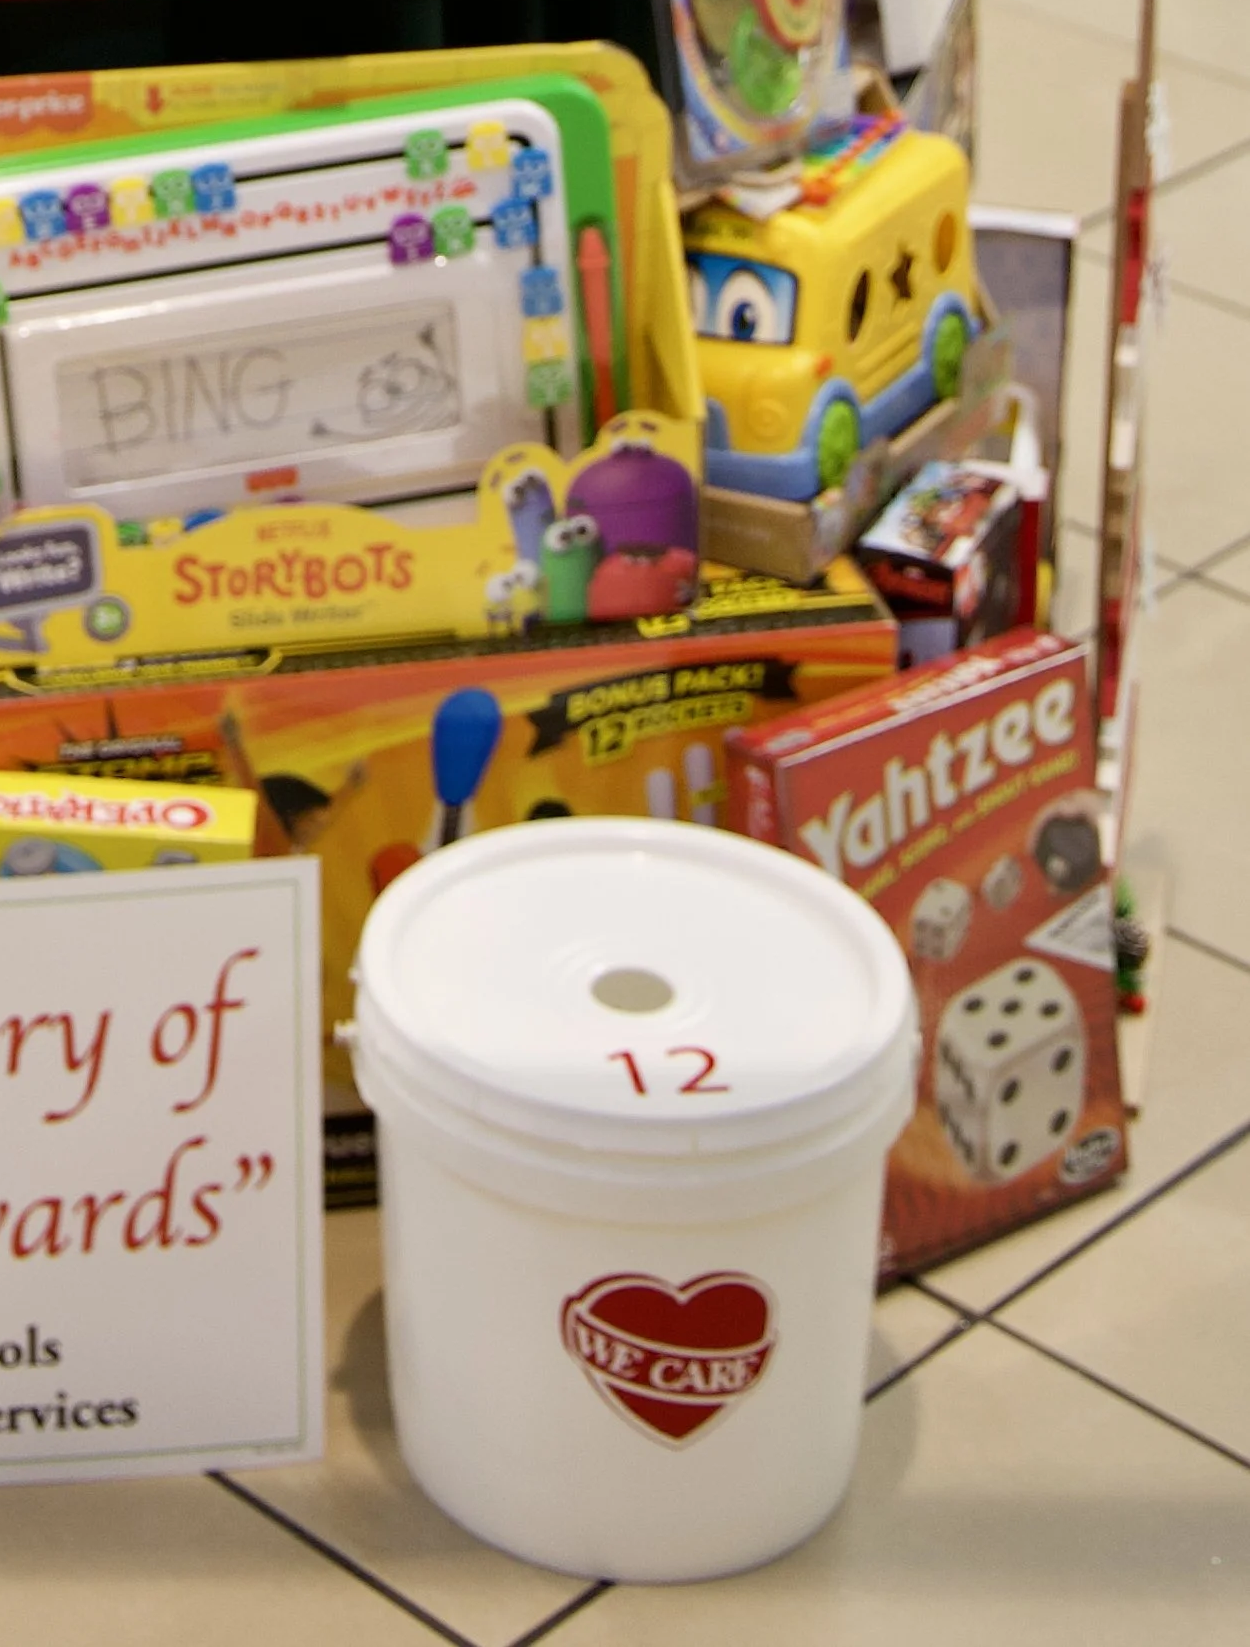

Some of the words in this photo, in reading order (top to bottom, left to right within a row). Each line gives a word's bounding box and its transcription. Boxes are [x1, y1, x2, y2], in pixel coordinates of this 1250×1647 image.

[89, 346, 293, 454] BING
[174, 542, 414, 606] STORYBOTS
[566, 672, 671, 722] BONUS
[672, 662, 767, 695] PACK!
[587, 720, 625, 757] 12
[798, 678, 1075, 877] Yahtzee
[151, 949, 260, 1113] of
[607, 1046, 732, 1096] 12
[575, 1324, 642, 1380] WE
[650, 1353, 760, 1393] CARE
